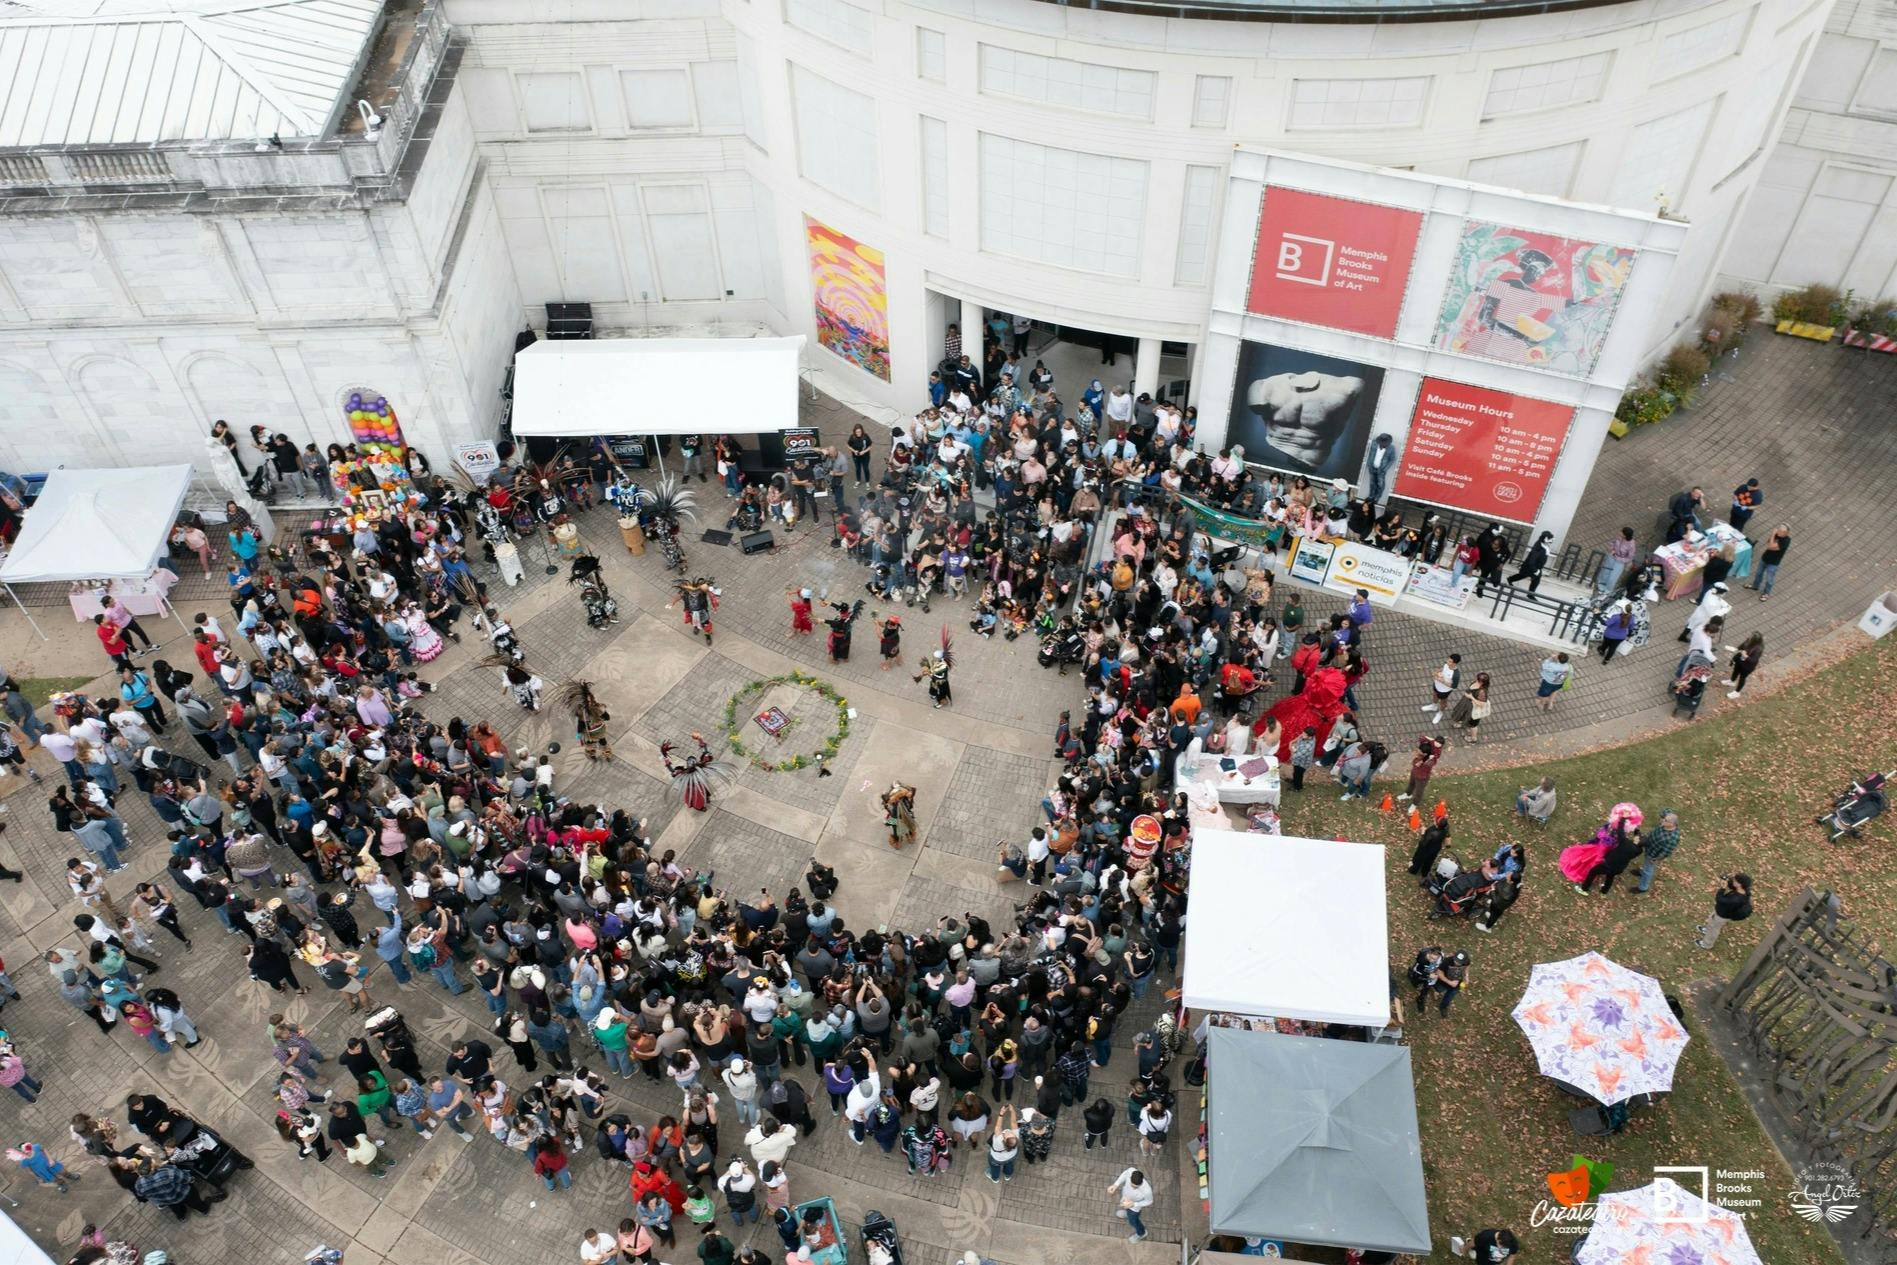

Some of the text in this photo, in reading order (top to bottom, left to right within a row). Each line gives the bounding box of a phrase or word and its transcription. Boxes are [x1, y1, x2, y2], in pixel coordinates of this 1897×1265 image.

[1277, 241, 1302, 271] B
[1340, 246, 1388, 262] Memphis
[1338, 257, 1373, 271] Brooks
[1336, 268, 1380, 283] Museum
[1334, 280, 1363, 291] of Art
[1427, 394, 1514, 419] Museum Hours
[1420, 419, 1461, 434] Thursday
[1497, 435, 1508, 443] 10
[1508, 438, 1523, 446] am
[1530, 441, 1537, 449] 8
[1537, 444, 1553, 453] pm
[1423, 410, 1474, 427] Wednesday
[1511, 428, 1526, 437] am
[1540, 435, 1556, 444] pm
[790, 439, 811, 447] 901
[1417, 428, 1445, 440] Friday
[1494, 444, 1504, 452] 10
[1505, 447, 1520, 455] am
[1534, 453, 1550, 462] pm
[1412, 446, 1445, 459] Sunday
[1496, 465, 1511, 473] am
[1525, 470, 1541, 479] pm
[1414, 437, 1454, 452] Saturday
[1502, 456, 1517, 464] am
[1530, 462, 1546, 471] pm
[1405, 471, 1465, 488] inside featuring
[1408, 463, 1473, 482] Visit Café Brooks
[1358, 569, 1394, 585] noticias
[1361, 560, 1403, 577] memphis
